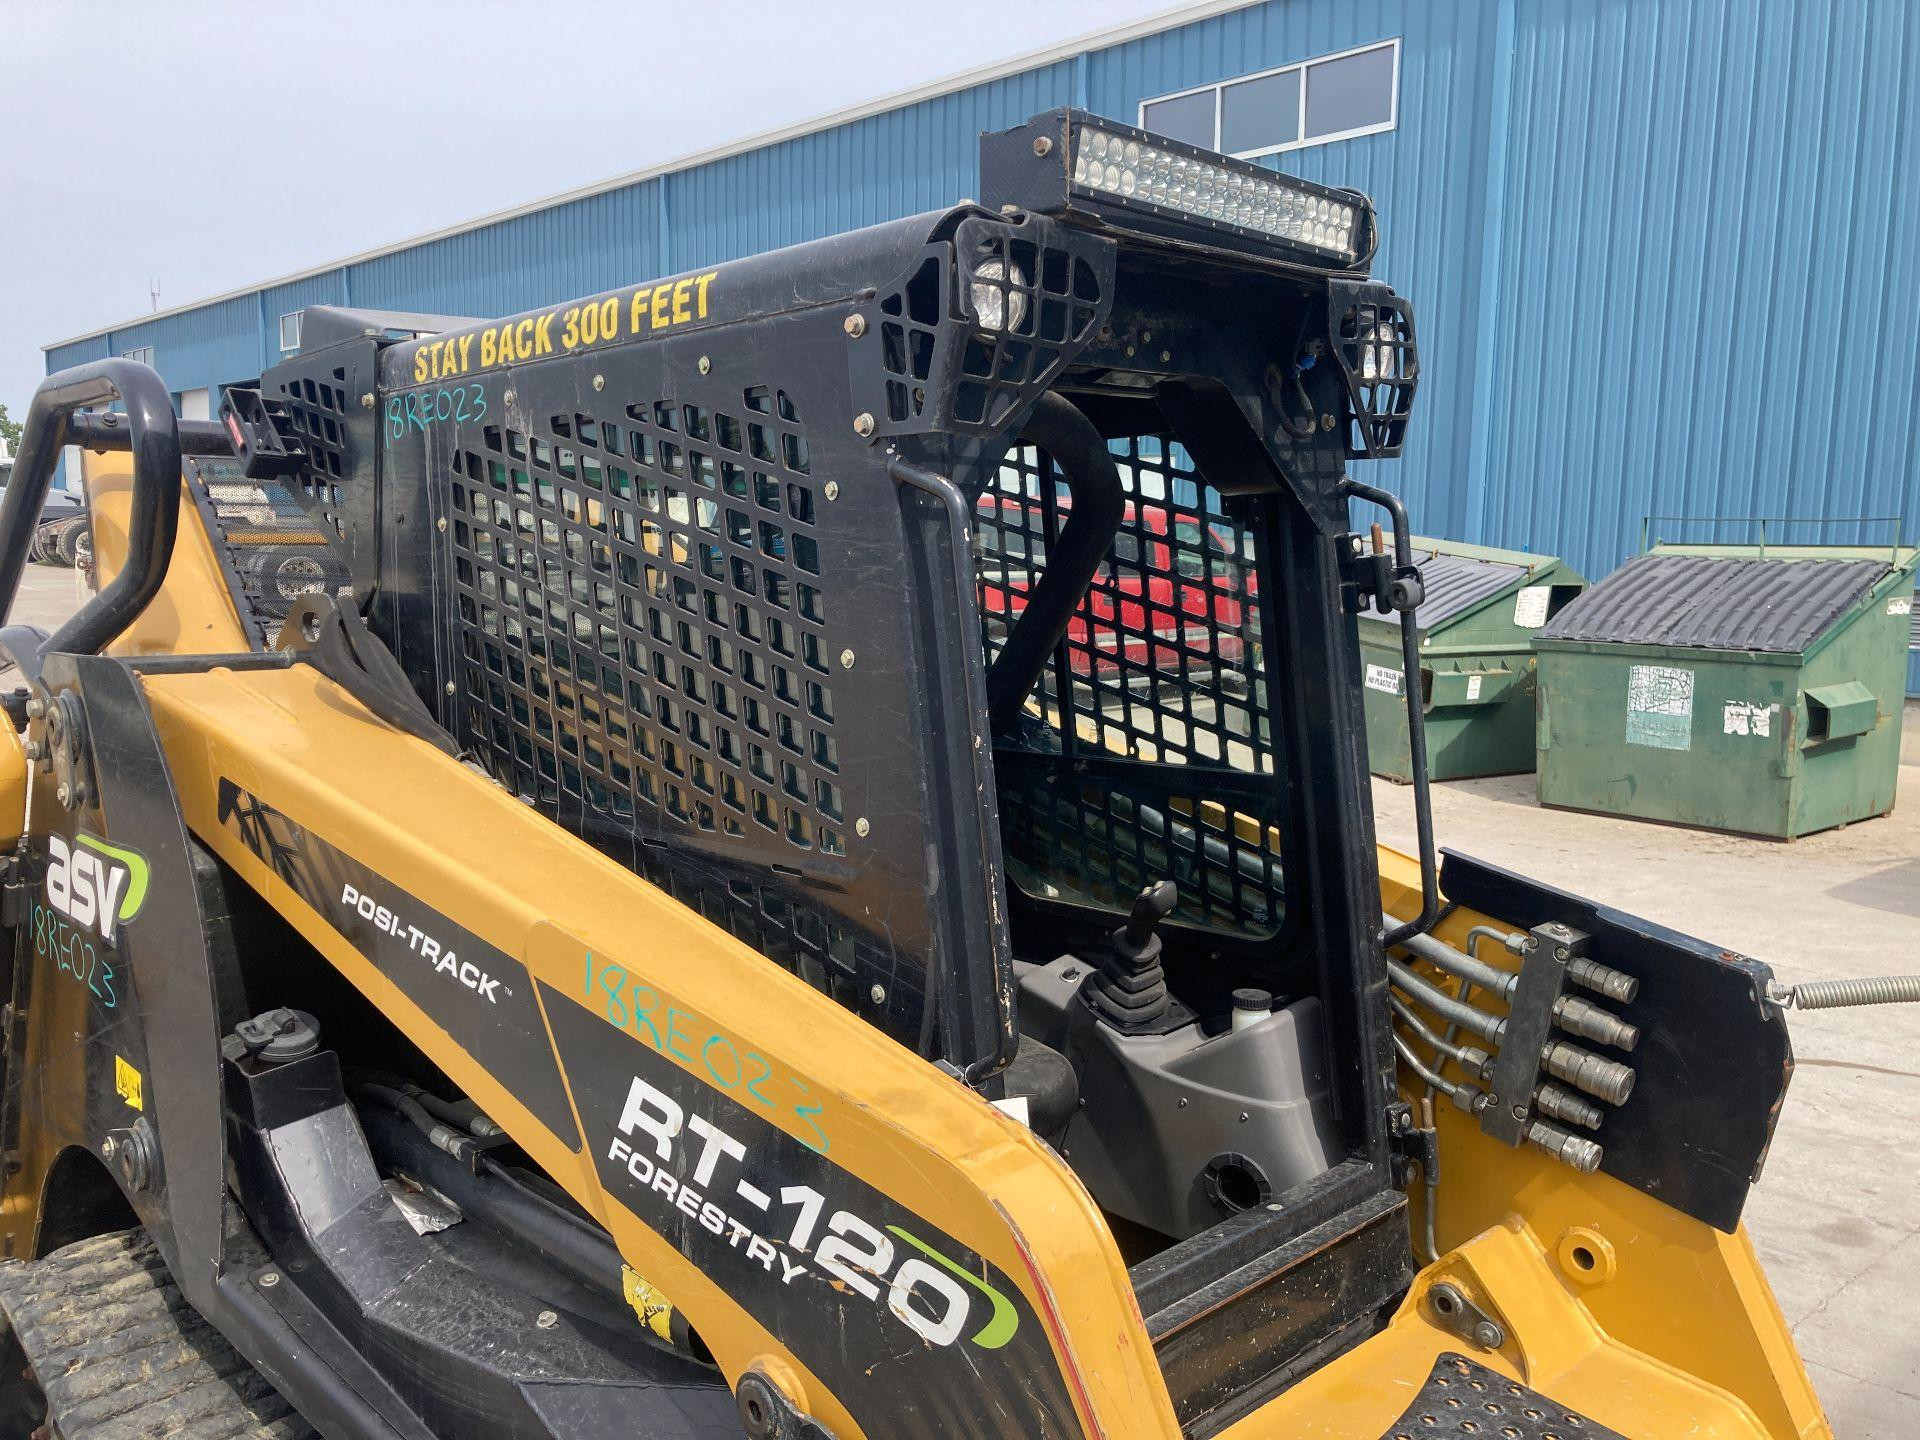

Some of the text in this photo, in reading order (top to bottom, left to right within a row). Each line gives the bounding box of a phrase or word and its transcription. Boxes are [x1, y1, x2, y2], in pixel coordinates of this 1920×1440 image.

[413, 271, 718, 384] STAY BACK 300 FEET
[341, 883, 501, 1004] POSI-TRACK
[608, 1136, 808, 1285] FORESTRY
[617, 1076, 970, 1347] RT-120
